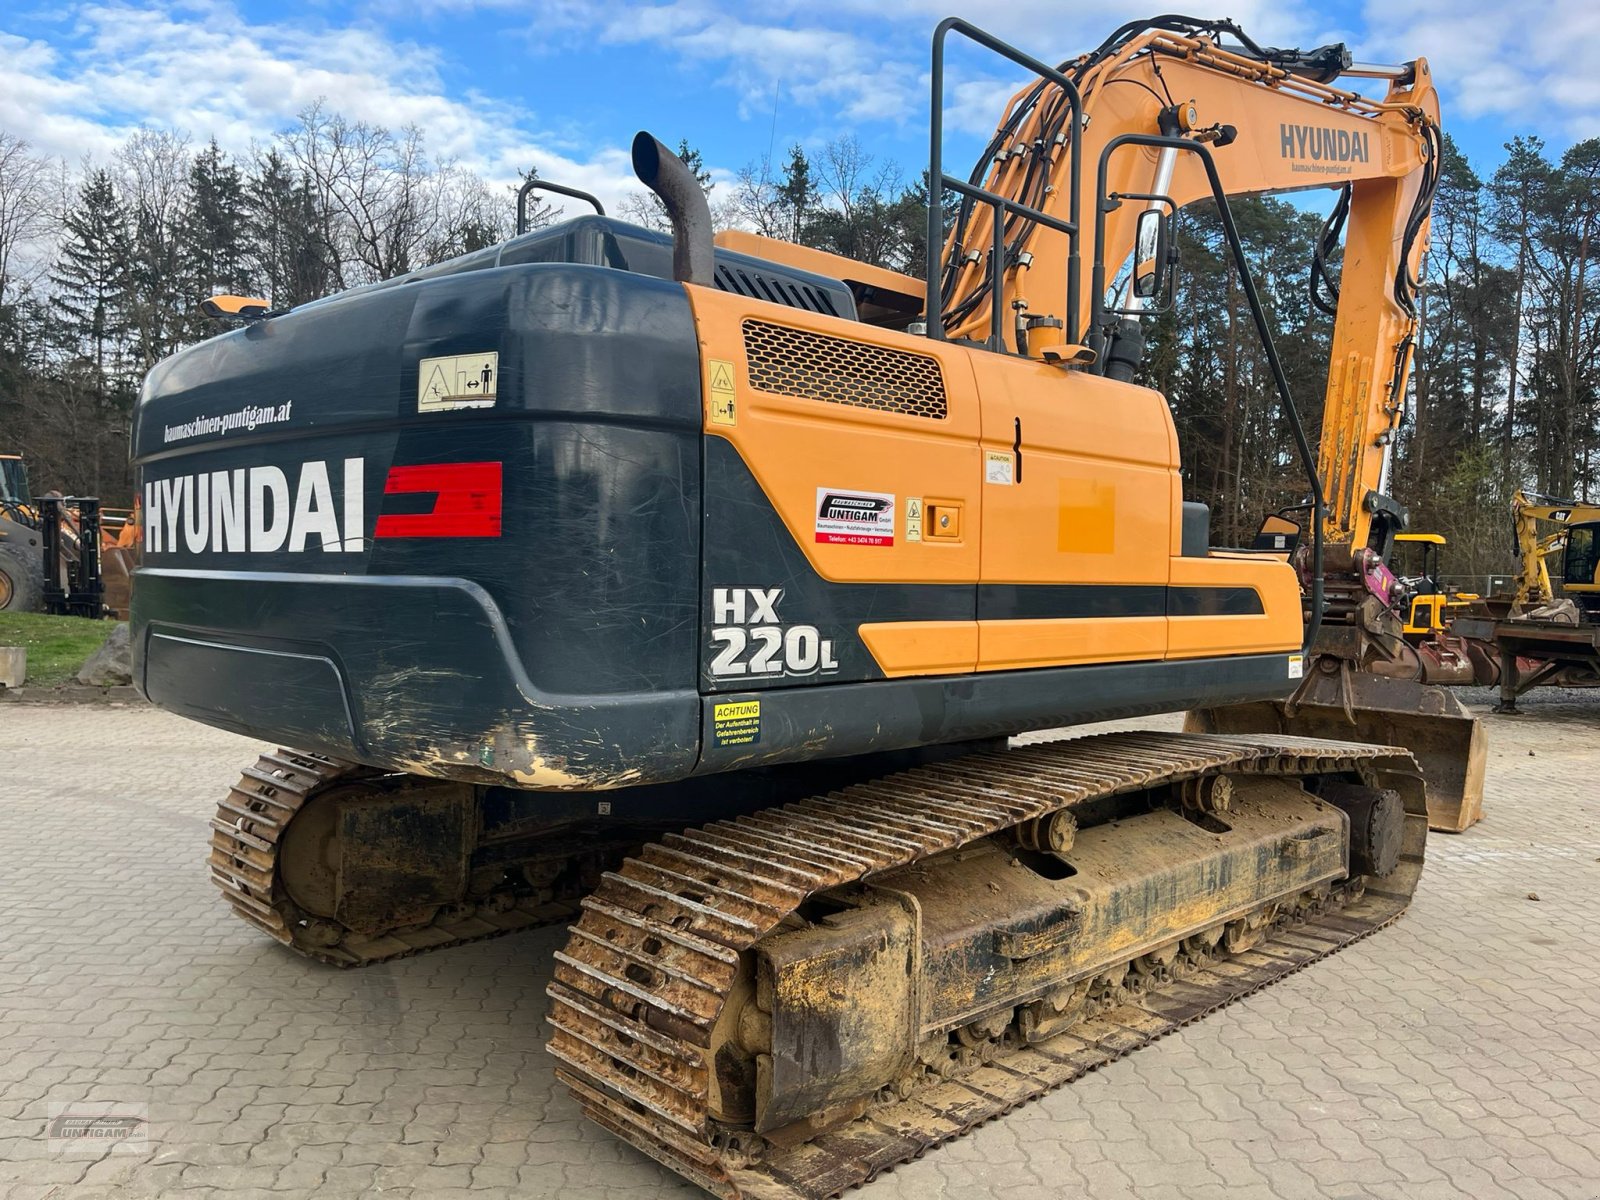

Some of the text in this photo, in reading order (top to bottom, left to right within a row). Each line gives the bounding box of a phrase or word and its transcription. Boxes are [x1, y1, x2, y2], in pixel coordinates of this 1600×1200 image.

[1280, 124, 1369, 163] HYUNDAI
[164, 400, 292, 443] baumaschinen-puntigam.at
[145, 457, 365, 553] HYUNDAI
[713, 588, 783, 624] HX
[716, 705, 759, 718] ACHTUNG
[726, 719, 752, 728] Aufenthalt
[716, 727, 759, 737] Gefahrenbereich
